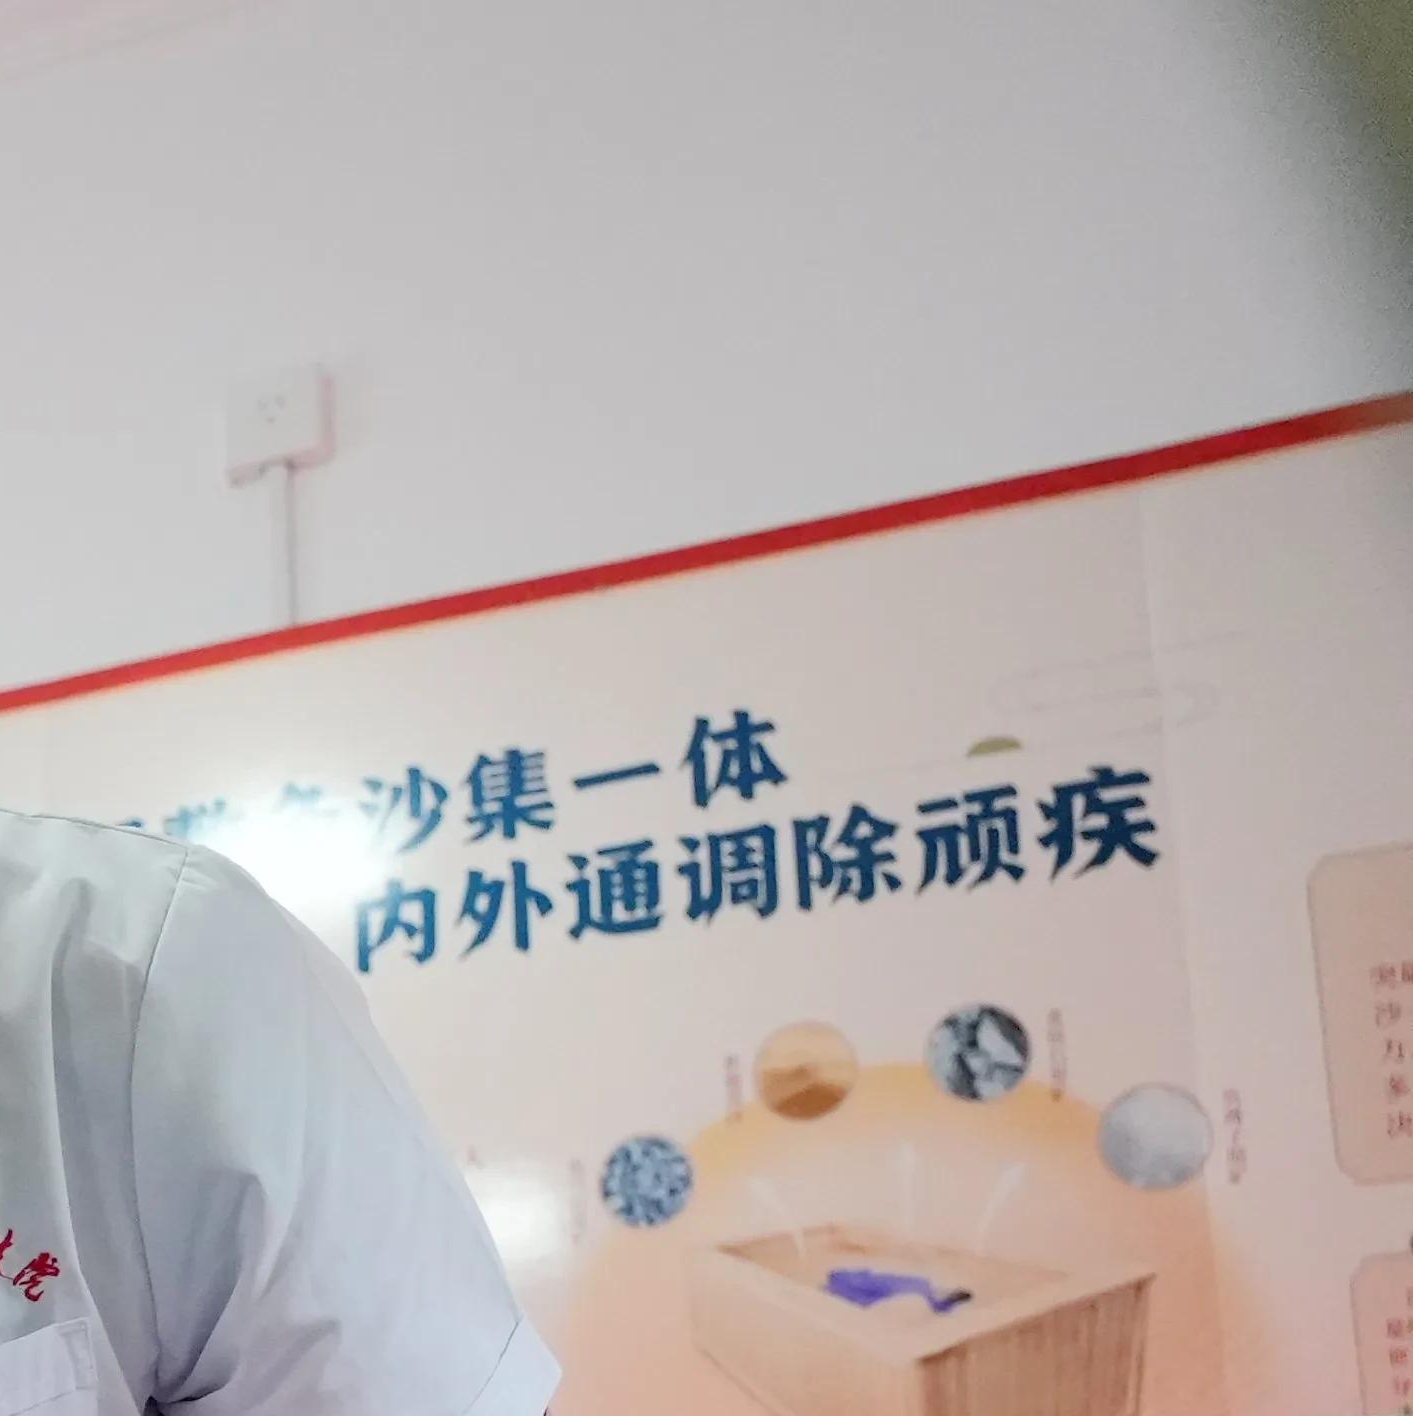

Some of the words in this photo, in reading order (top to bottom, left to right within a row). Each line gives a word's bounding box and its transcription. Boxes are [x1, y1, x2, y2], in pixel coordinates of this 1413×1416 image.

[355, 764, 1160, 974] 内外通调除顽疾
